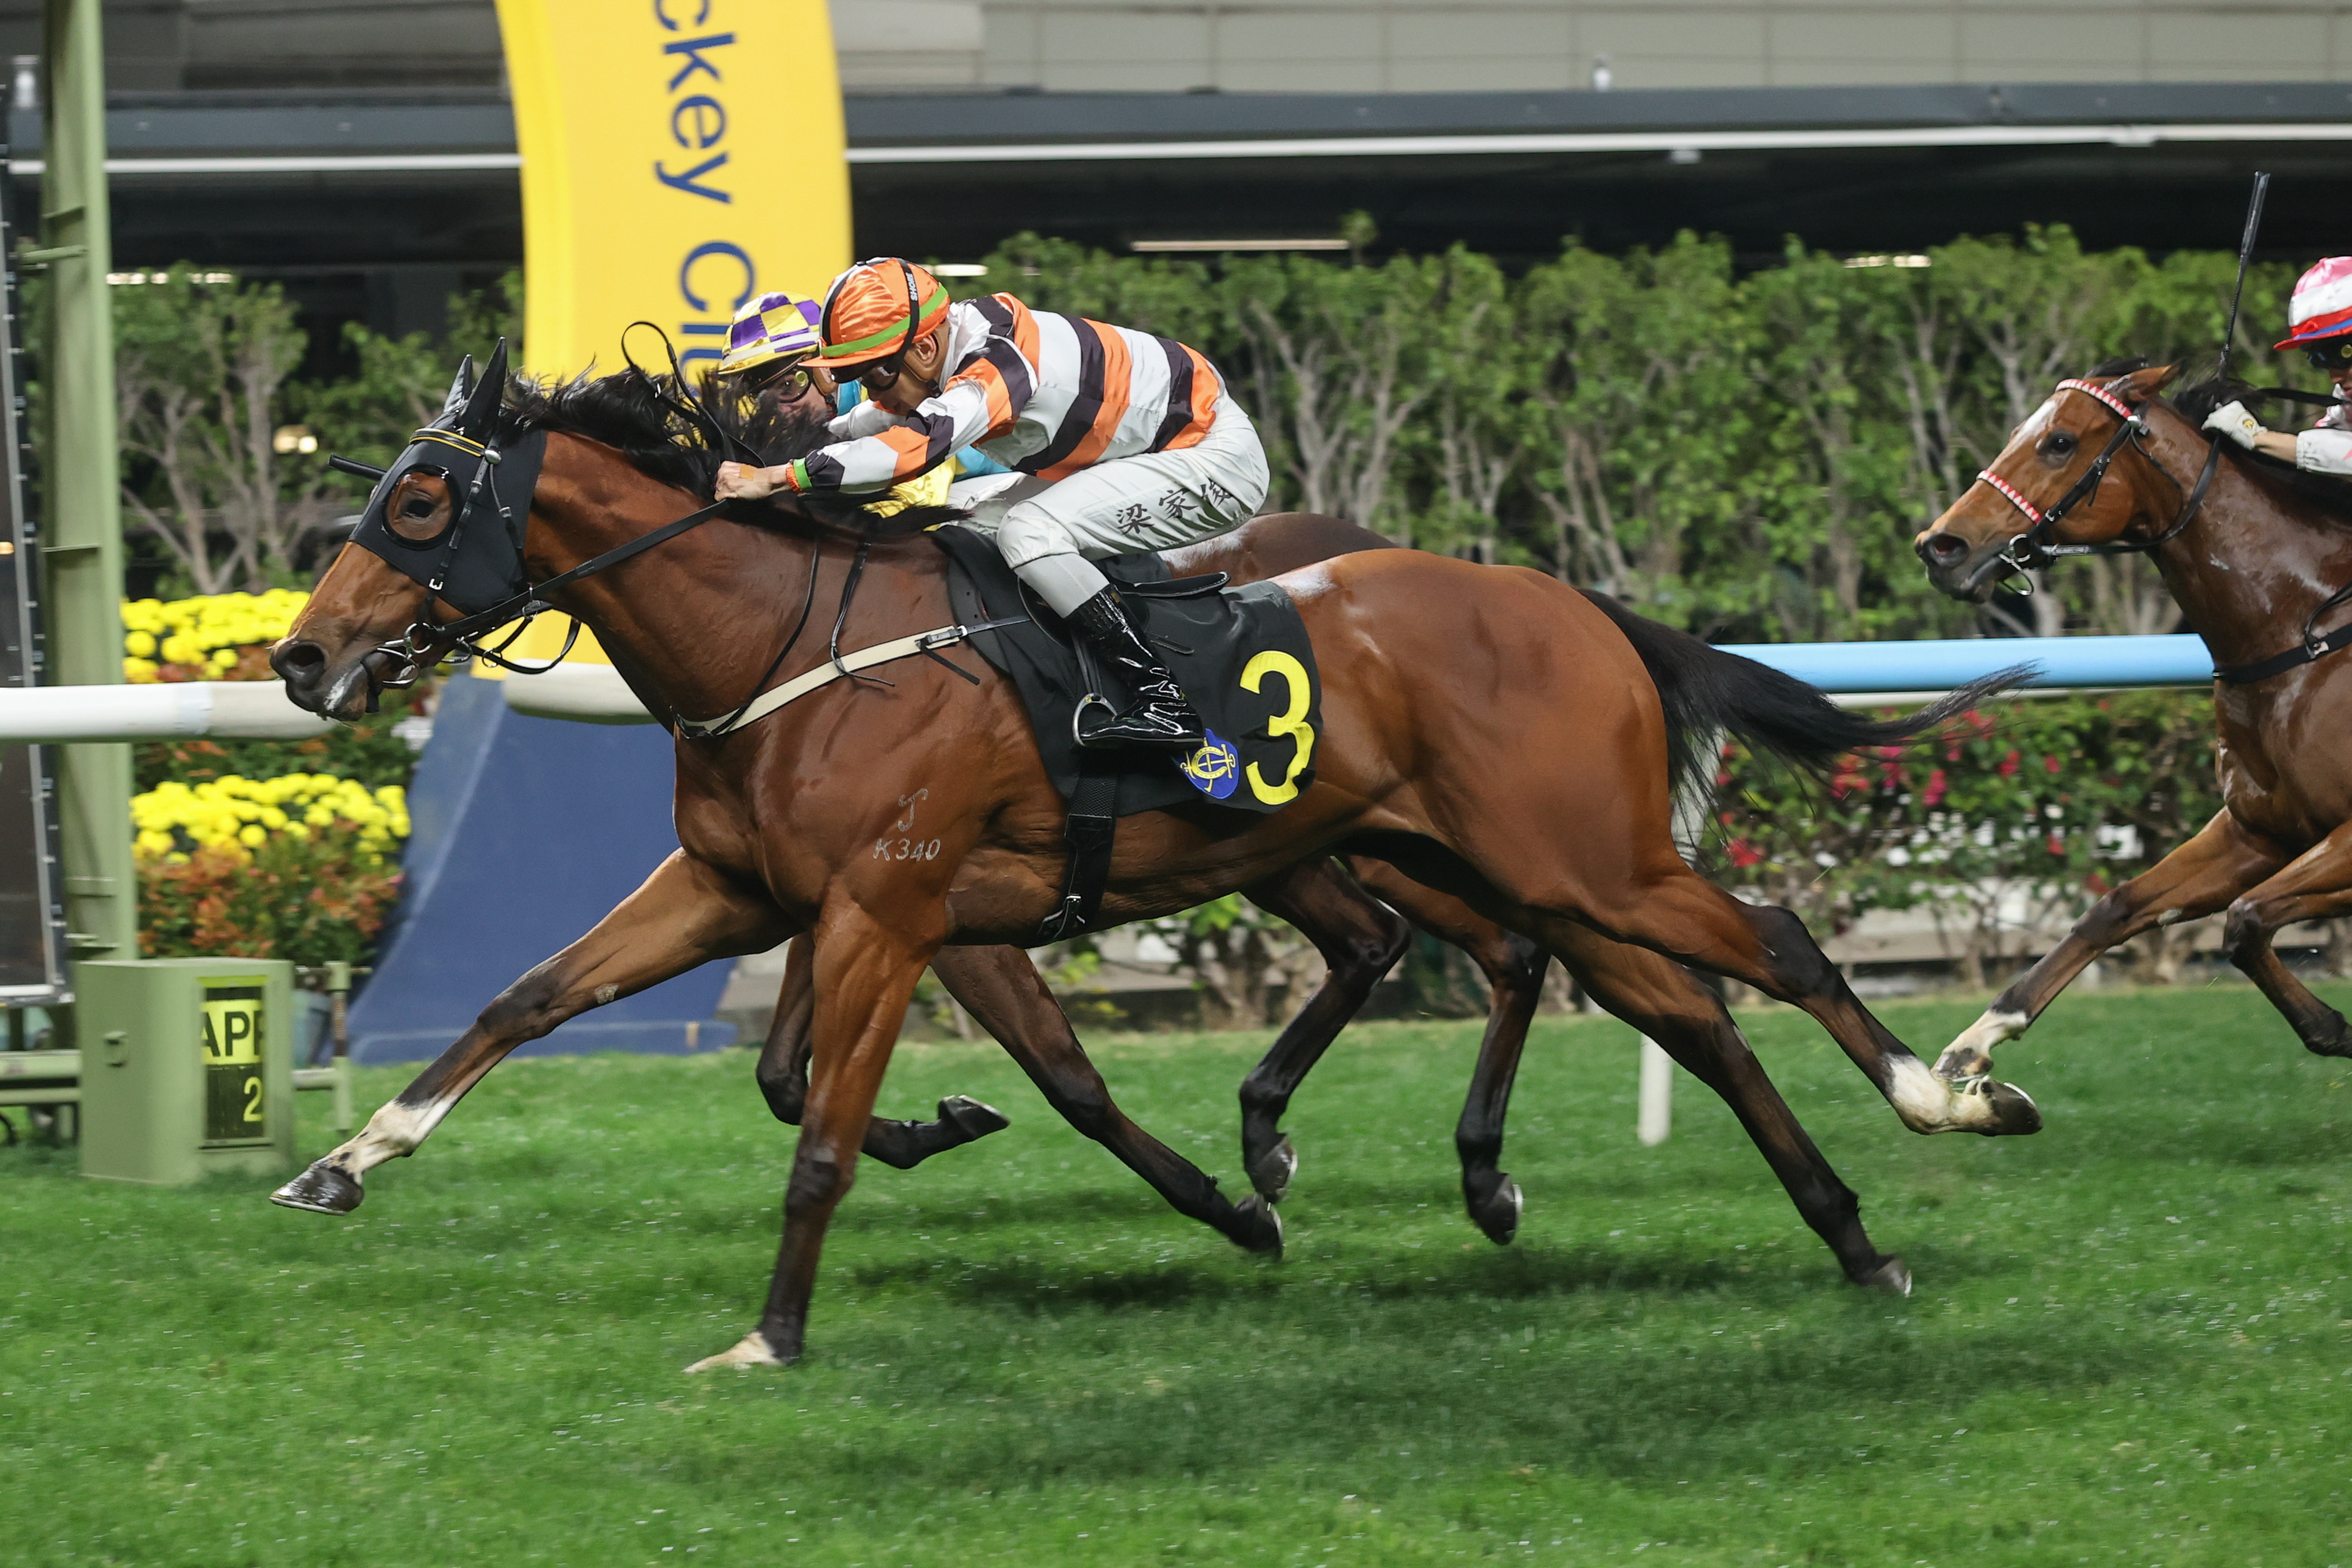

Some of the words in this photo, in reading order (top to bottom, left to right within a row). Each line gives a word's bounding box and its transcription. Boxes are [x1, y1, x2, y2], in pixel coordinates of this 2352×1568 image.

[1239, 650, 1315, 805] 3
[872, 837, 941, 861] K340
[243, 1076, 263, 1122] 2
